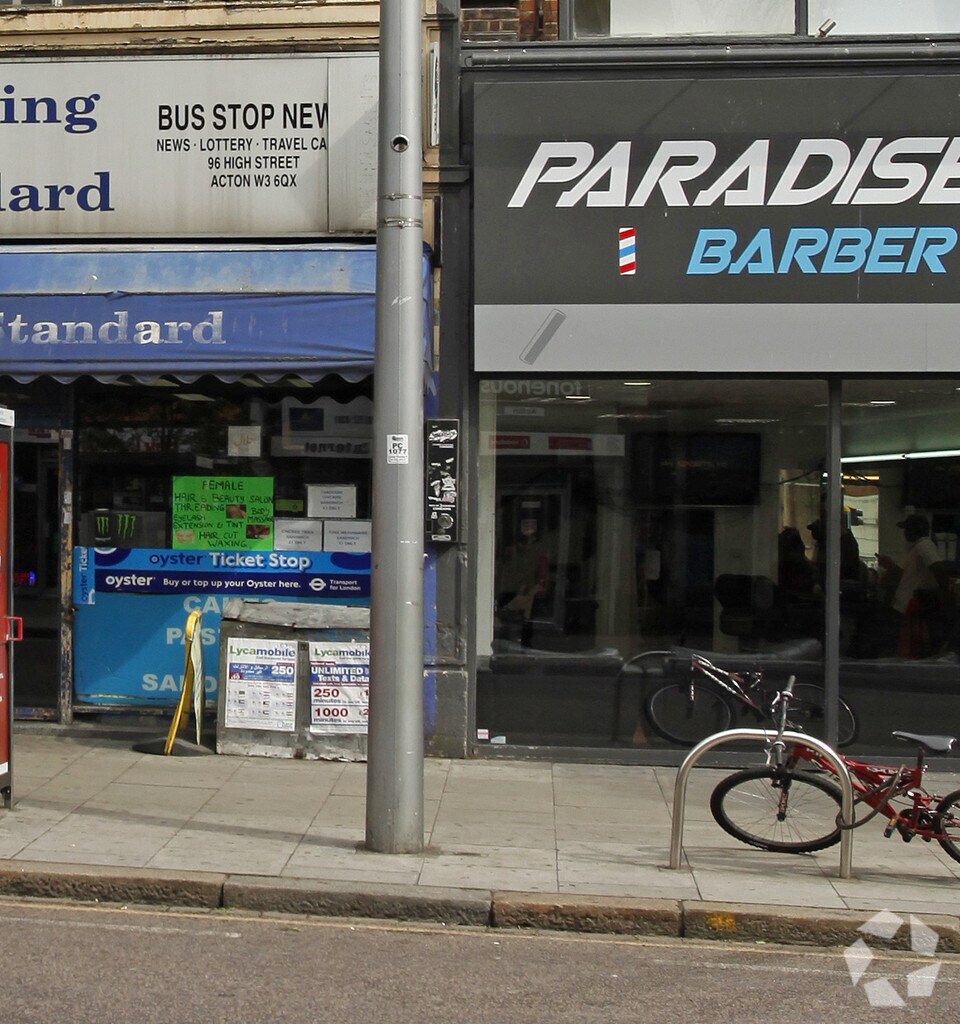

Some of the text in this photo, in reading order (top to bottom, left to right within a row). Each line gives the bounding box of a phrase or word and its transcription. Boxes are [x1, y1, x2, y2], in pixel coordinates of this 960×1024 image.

[158, 104, 205, 130] BUS
[212, 103, 274, 130] STOP
[157, 138, 190, 152] NEWS
[200, 138, 253, 152] LOTTERY
[263, 138, 308, 151] TRAVEL
[208, 155, 300, 170] 96 HIGH STREET
[211, 174, 297, 188] ACTON W3 6QX
[686, 226, 958, 275] BARBER
[201, 480, 244, 491] FEMALE
[174, 492, 197, 503] HAIR
[212, 493, 245, 504] BEAUTY
[249, 495, 275, 505] SALON
[175, 503, 225, 512] THREADING
[208, 540, 247, 548] WAXING
[149, 552, 312, 571] oyster Ticket Stop
[105, 574, 153, 589] oyster
[163, 578, 180, 588] Buy
[193, 579, 209, 588] top
[211, 580, 223, 588] up
[224, 580, 245, 589] your
[246, 579, 277, 589] Oyster
[278, 579, 301, 588] here.
[229, 645, 296, 657] Lycamobile
[271, 666, 294, 675] 250
[311, 667, 364, 675] UNLIMITED
[313, 688, 340, 698] 250
[315, 707, 349, 717] 1000
